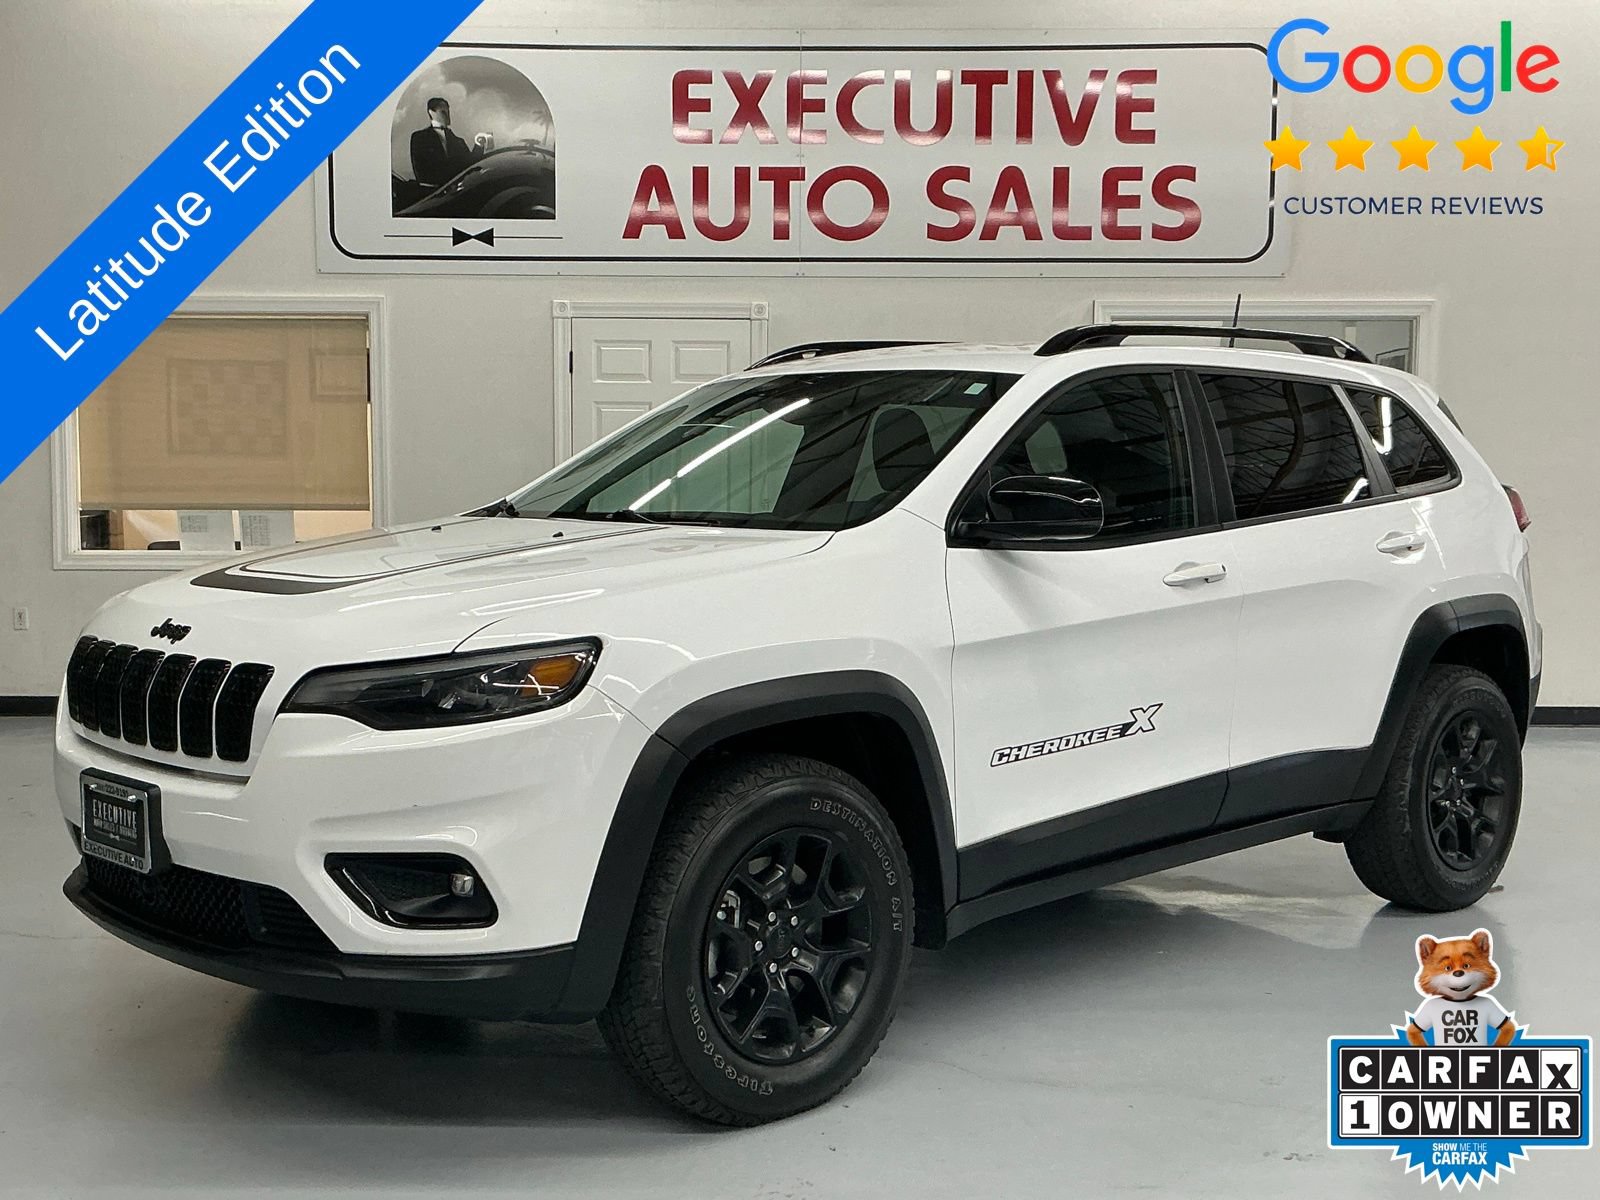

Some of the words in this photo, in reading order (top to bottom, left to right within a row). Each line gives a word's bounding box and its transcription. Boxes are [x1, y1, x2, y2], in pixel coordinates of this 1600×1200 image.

[672, 69, 1158, 145] EXECUTIVE
[622, 164, 890, 242] AUTO
[926, 165, 1202, 242] SALES
[991, 724, 1124, 767] CHEROKEE
[1125, 703, 1164, 736] X
[92, 799, 137, 829] EXECUTIVE
[84, 840, 124, 863] EXECUTIVE
[810, 798, 898, 886] DESTINATION
[890, 896, 902, 932] A/T
